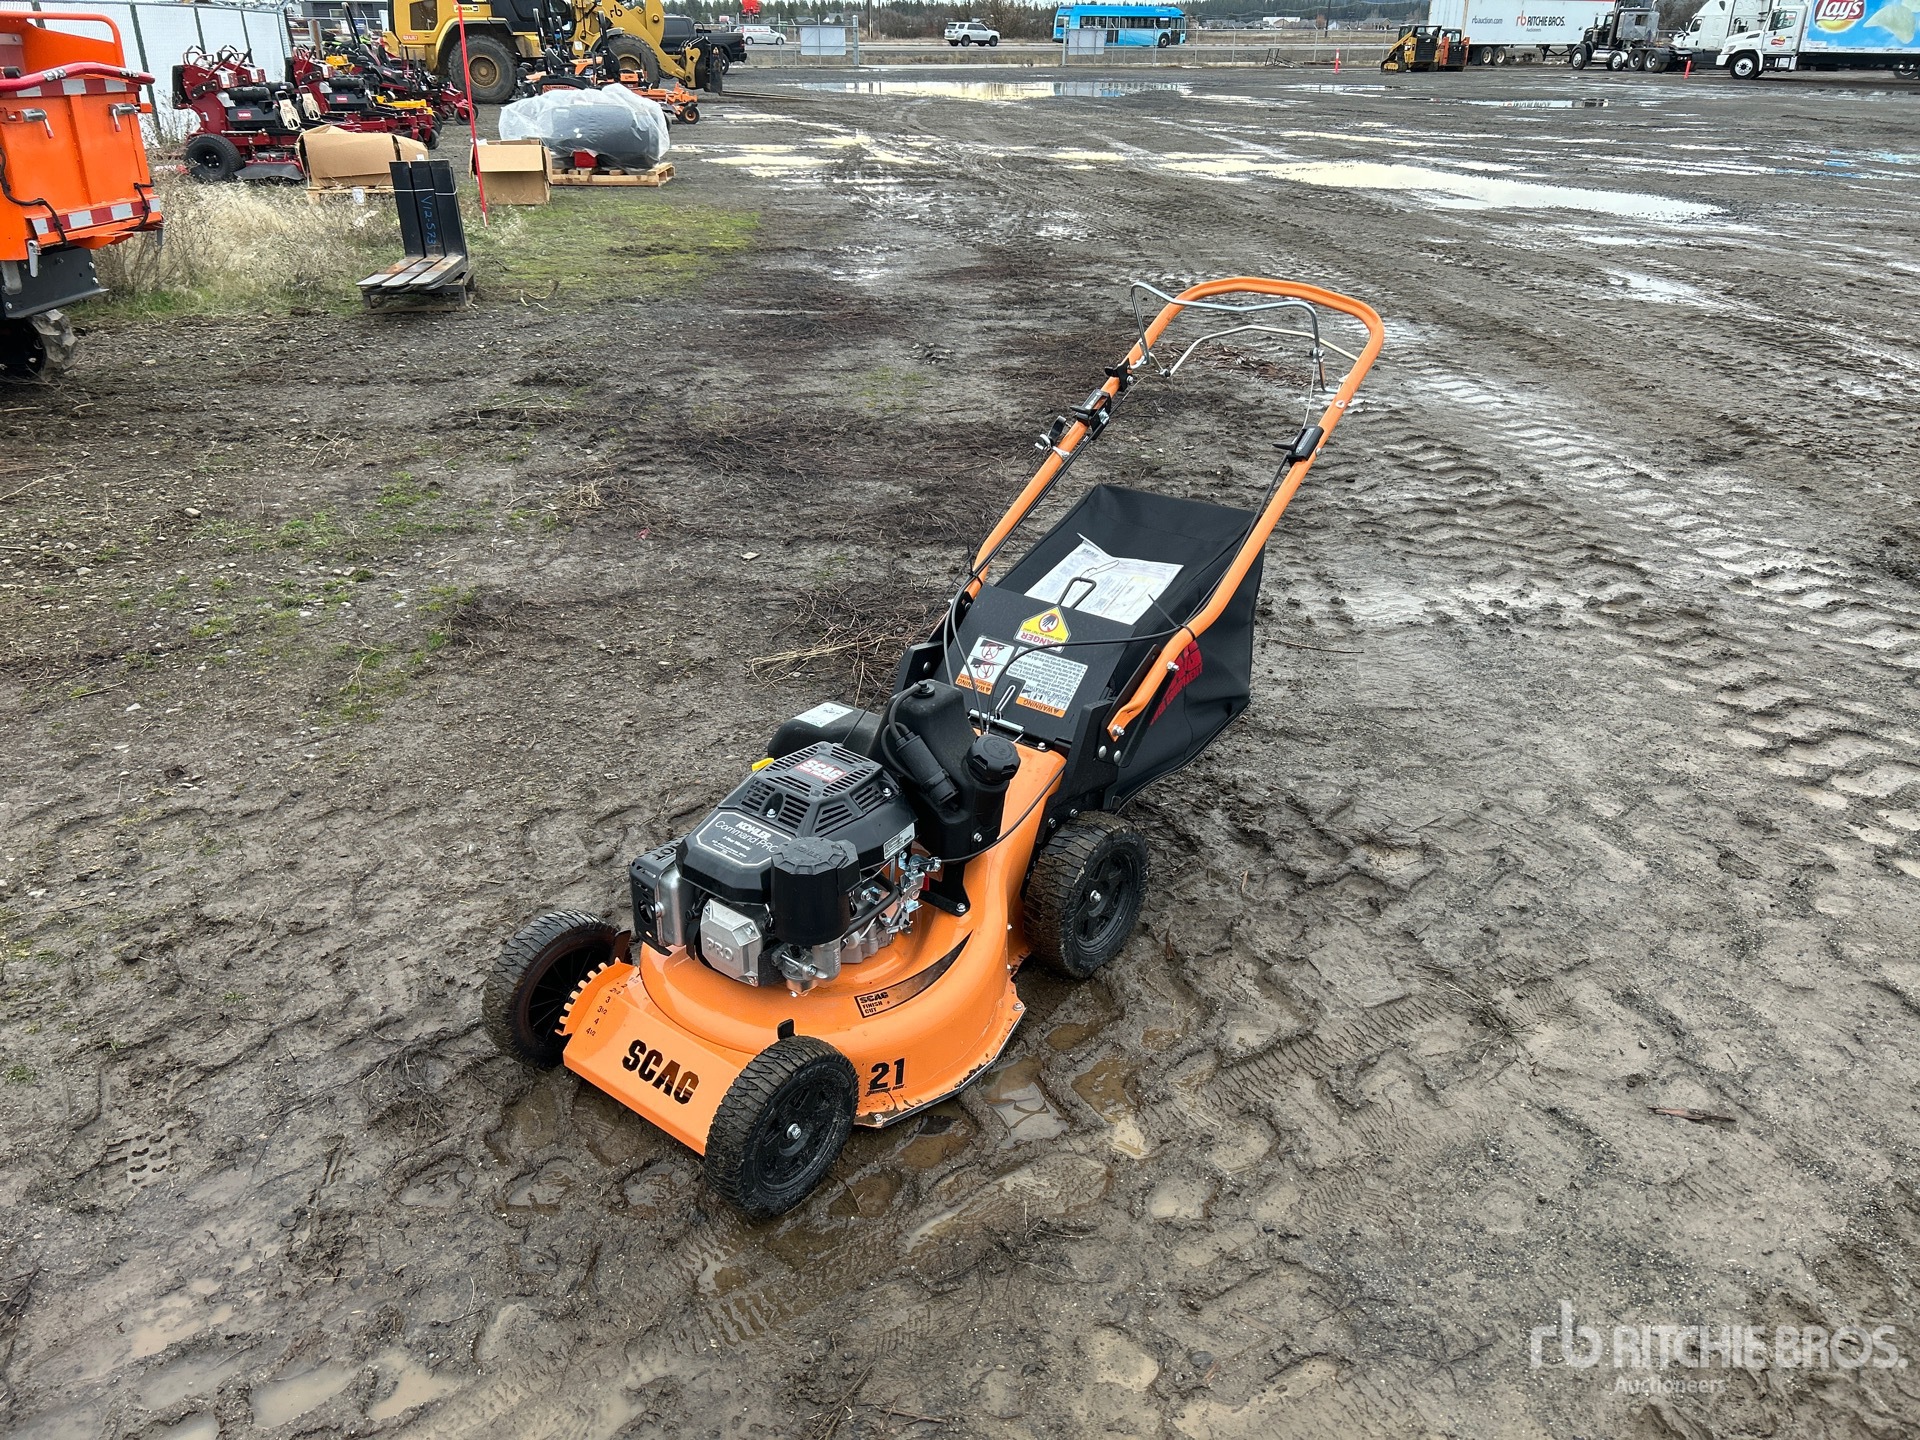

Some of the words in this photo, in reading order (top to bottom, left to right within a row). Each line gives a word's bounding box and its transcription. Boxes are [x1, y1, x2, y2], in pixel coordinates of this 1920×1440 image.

[610, 4, 623, 18] rb
[1516, 10, 1527, 27] rb
[1526, 16, 1548, 26] RITCHIE
[1022, 698, 1053, 713] WARNING
[802, 759, 845, 779] SCAG
[715, 820, 758, 844] Command
[735, 821, 772, 841] KOHLER
[706, 937, 734, 961] PRO
[605, 995, 611, 1004] 3
[860, 991, 889, 1004] SCAG
[862, 1000, 883, 1009] FINISH
[593, 1017, 600, 1025] 4
[621, 1038, 700, 1105] SCAG
[869, 1057, 906, 1091] 21
